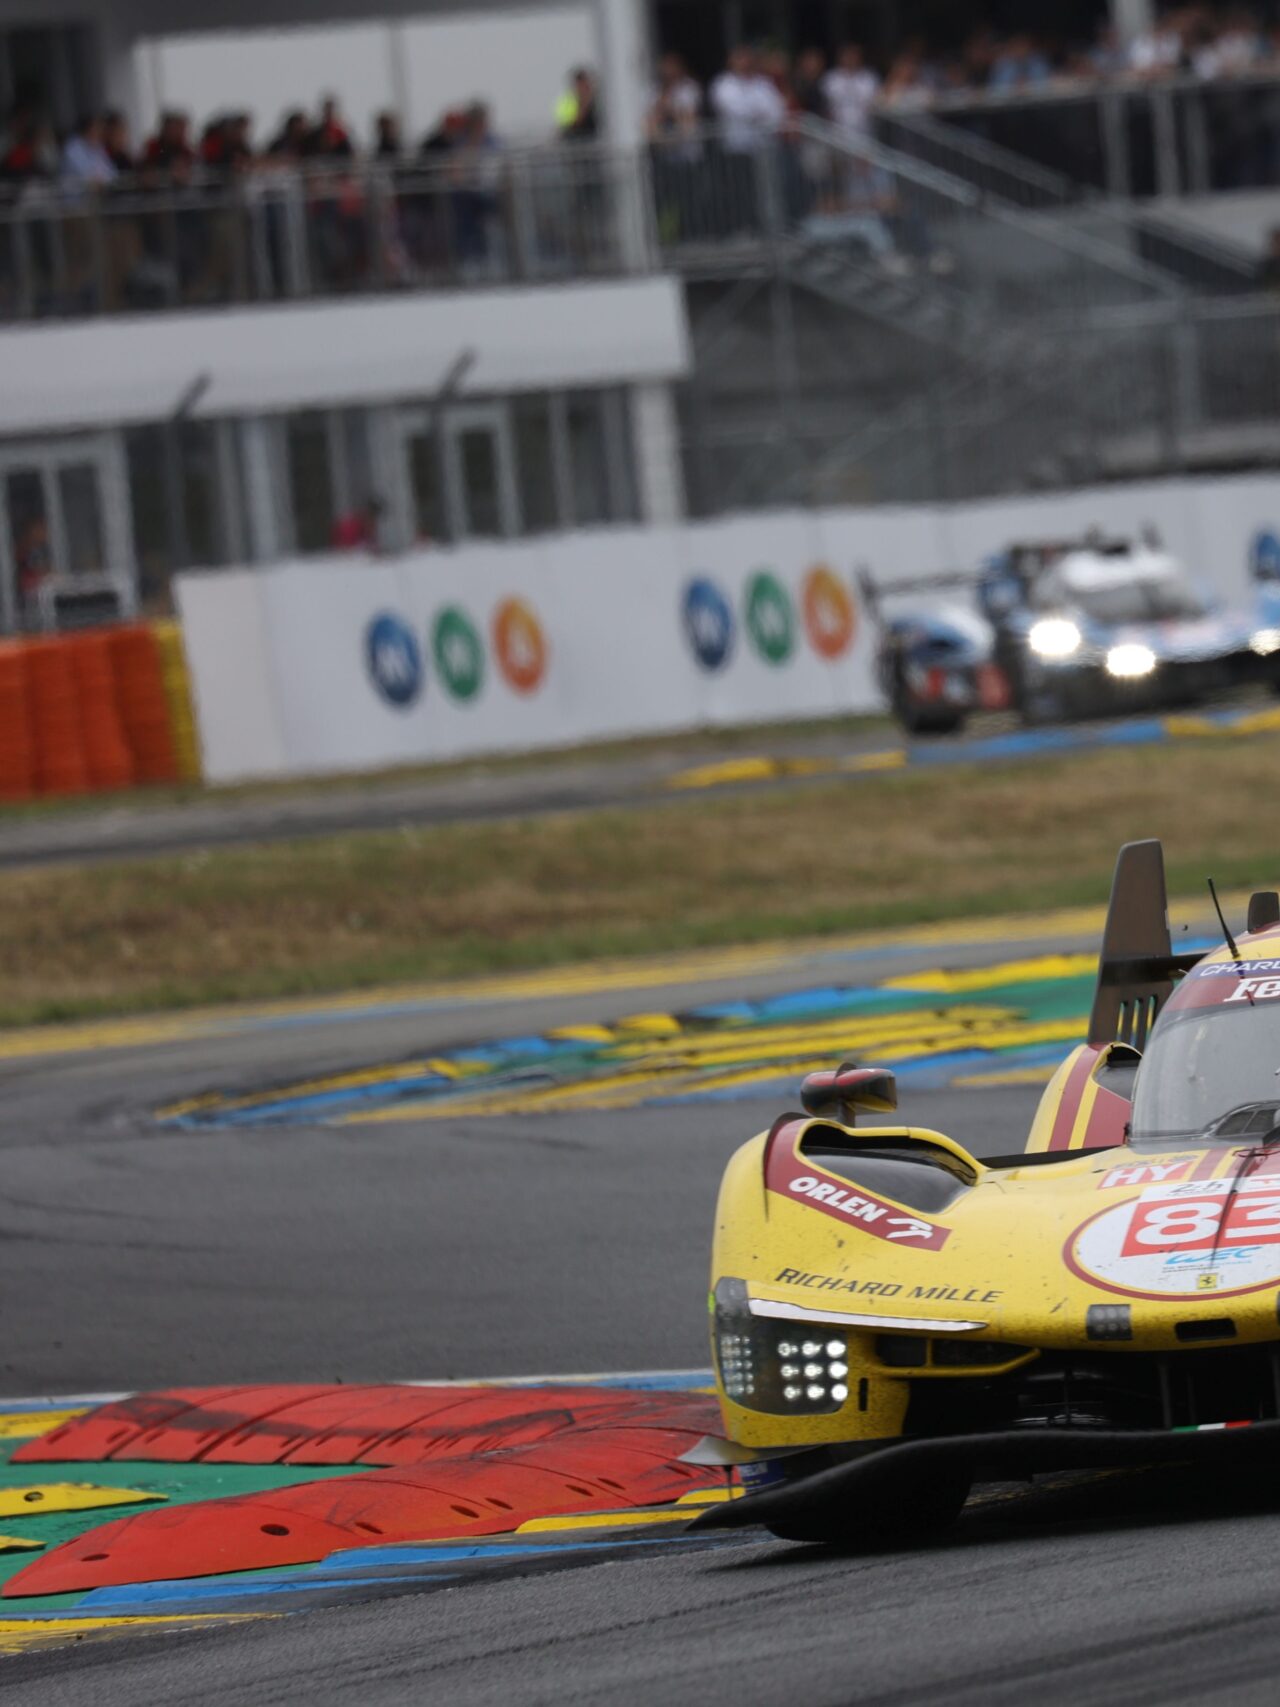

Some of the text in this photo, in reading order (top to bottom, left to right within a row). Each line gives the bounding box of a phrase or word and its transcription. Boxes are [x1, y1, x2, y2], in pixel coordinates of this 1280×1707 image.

[1102, 1162, 1190, 1188] HY
[788, 1176, 889, 1223] ORLEN
[775, 1268, 1005, 1303] RICHARD MILLE
